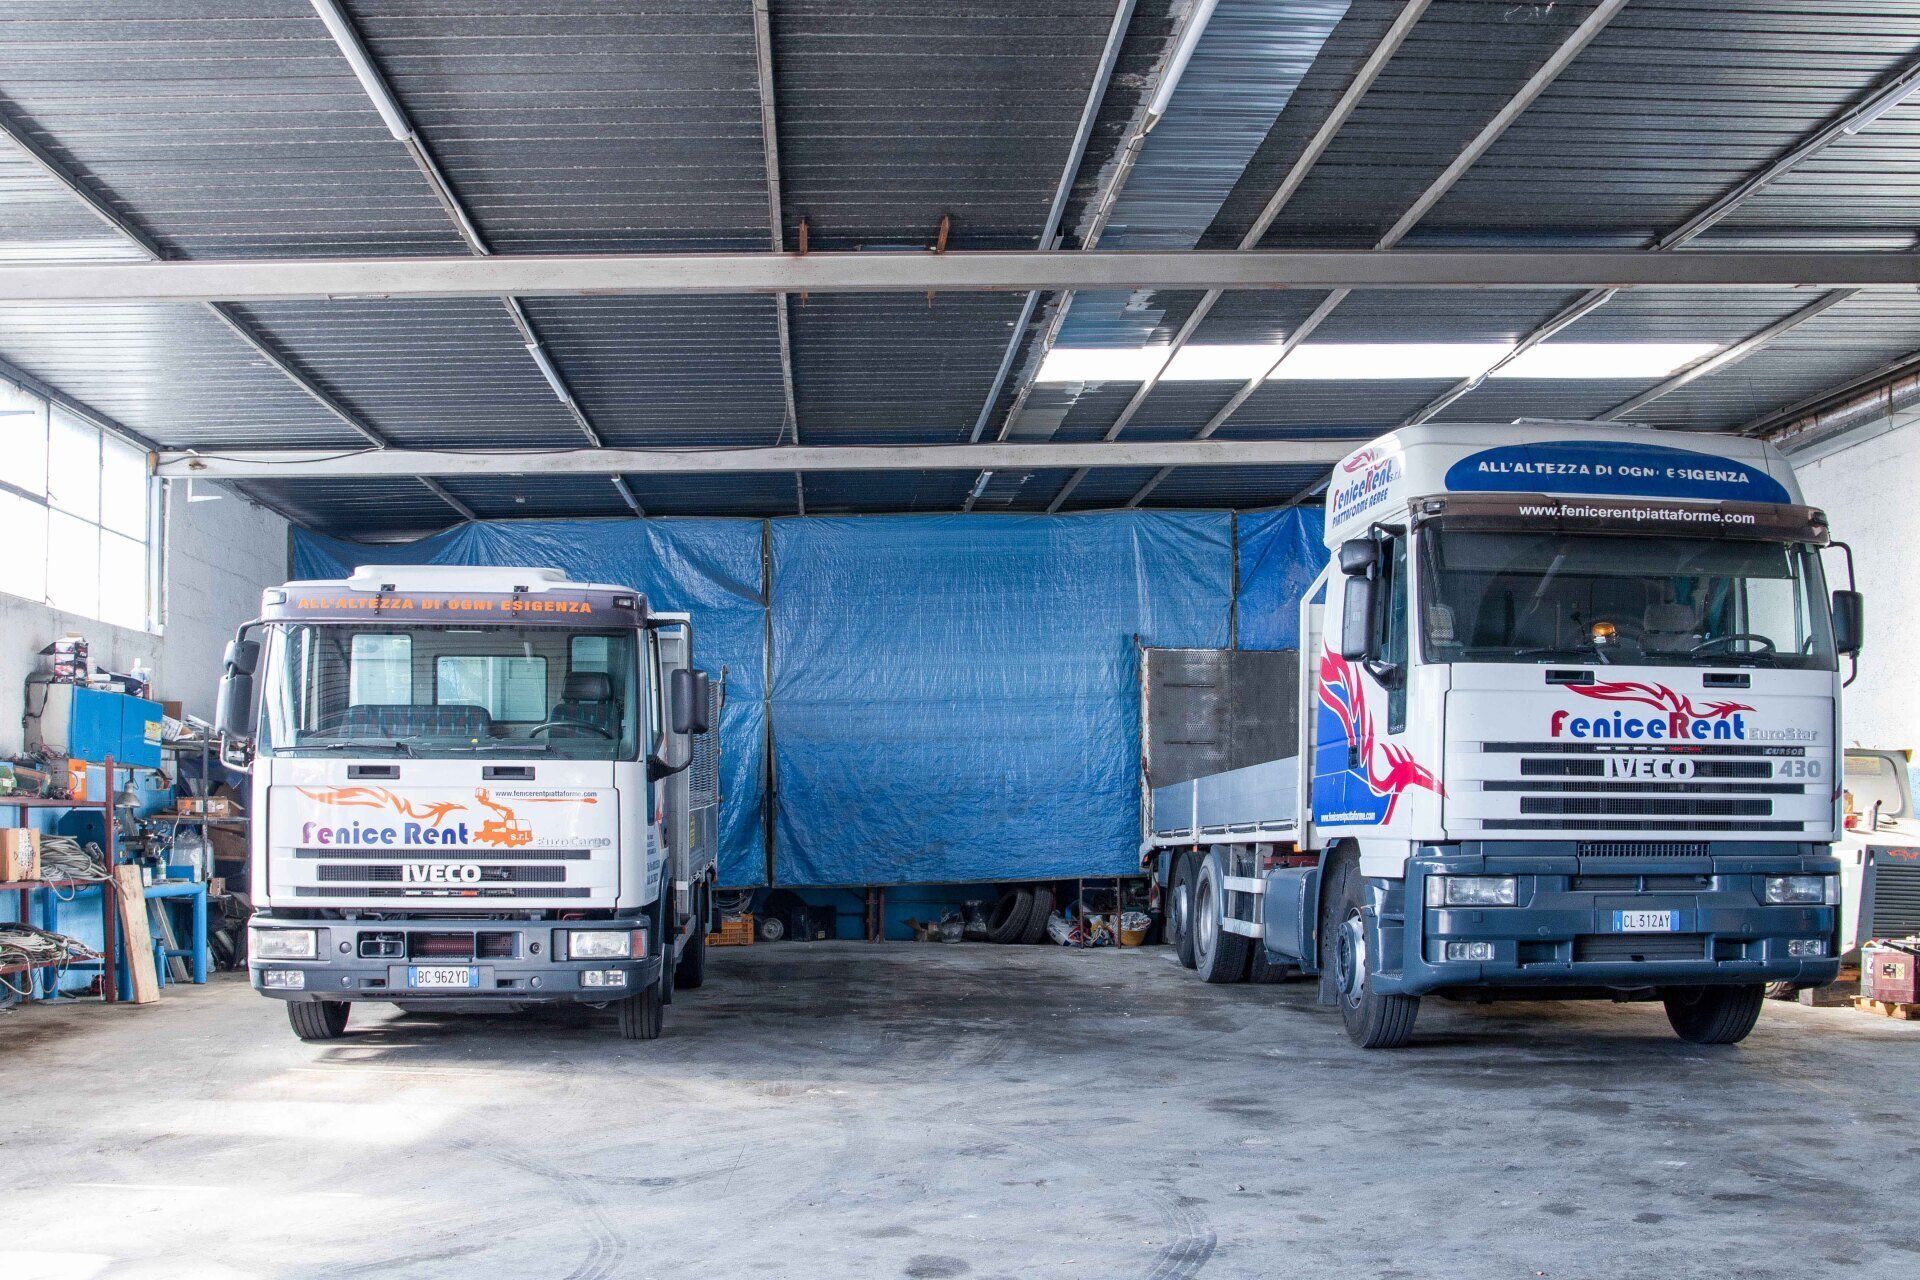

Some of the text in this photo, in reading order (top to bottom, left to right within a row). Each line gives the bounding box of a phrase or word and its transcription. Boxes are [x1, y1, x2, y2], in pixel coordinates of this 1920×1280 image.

[1478, 461, 1590, 475] ALL'ALTEZZA
[1595, 464, 1613, 476] DI
[1666, 468, 1750, 484] ESIGENZA
[1519, 504, 1755, 524] www.fenicerentpiattaforme.com
[297, 598, 592, 614] ALL'ALTEZZA DI OGNI ESIGENZA
[1747, 727, 1818, 741] EuroStar
[1765, 747, 1804, 756] CURSOR
[1603, 757, 1696, 779] IVECO
[1779, 760, 1821, 778] 430
[404, 822, 469, 845] Rent
[402, 864, 482, 883] IVECO
[418, 970, 431, 984] BC
